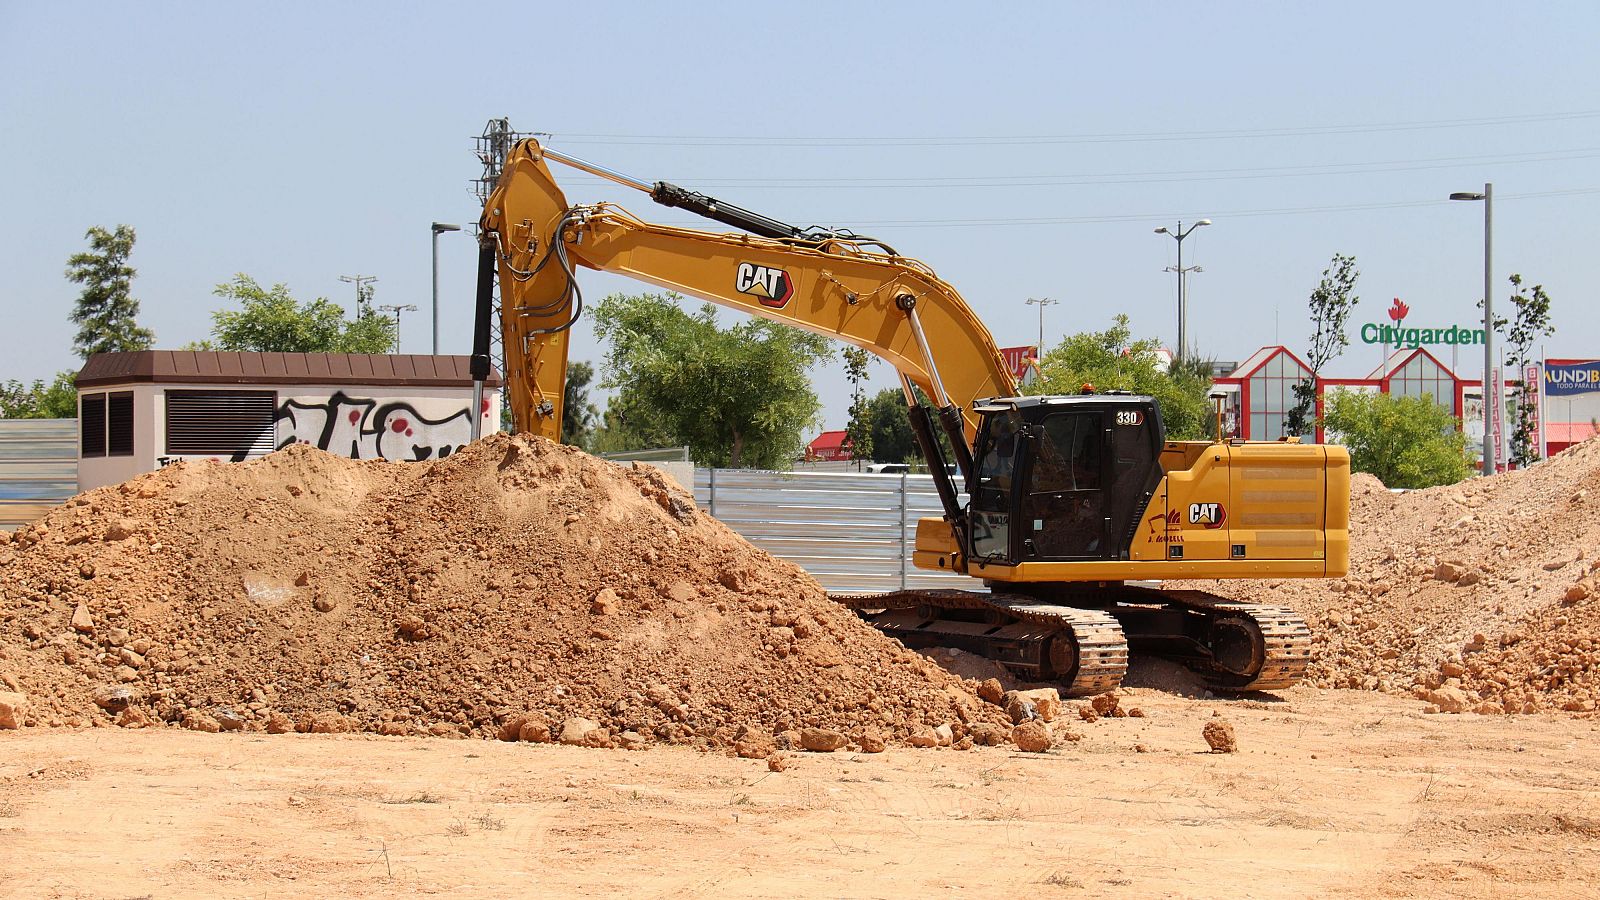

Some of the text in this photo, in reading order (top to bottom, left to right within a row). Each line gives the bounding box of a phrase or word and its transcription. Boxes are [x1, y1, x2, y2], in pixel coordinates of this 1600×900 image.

[736, 263, 783, 298] CAT
[1361, 323, 1486, 349] Citygarden
[1117, 411, 1137, 424] 330
[1190, 503, 1218, 524] CAT
